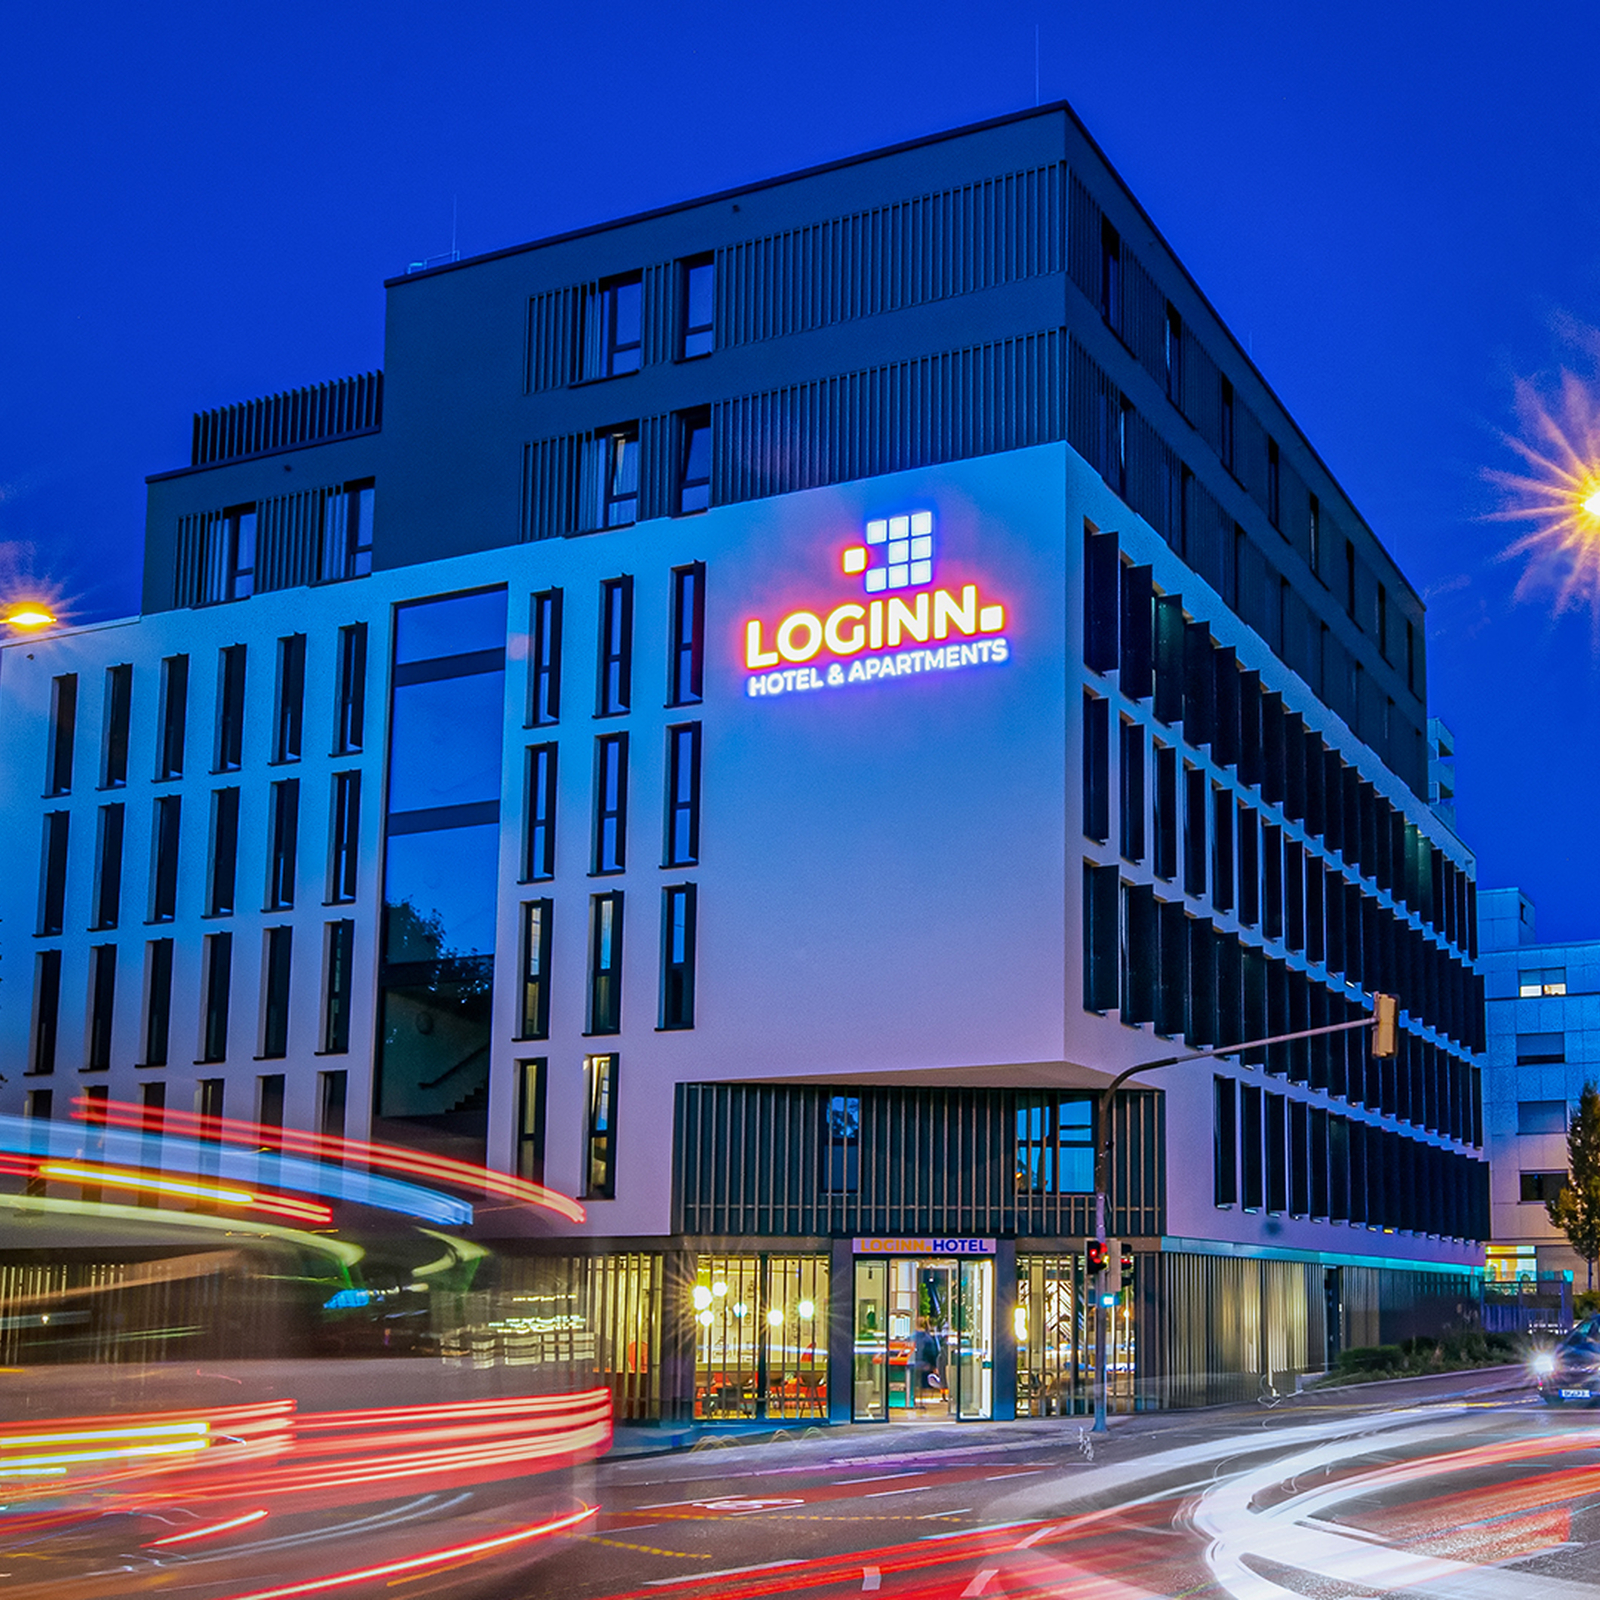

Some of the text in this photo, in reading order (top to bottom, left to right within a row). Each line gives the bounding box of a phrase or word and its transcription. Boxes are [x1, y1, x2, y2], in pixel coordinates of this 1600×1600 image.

[749, 638, 1007, 697] HOTEL & APARTMENTS
